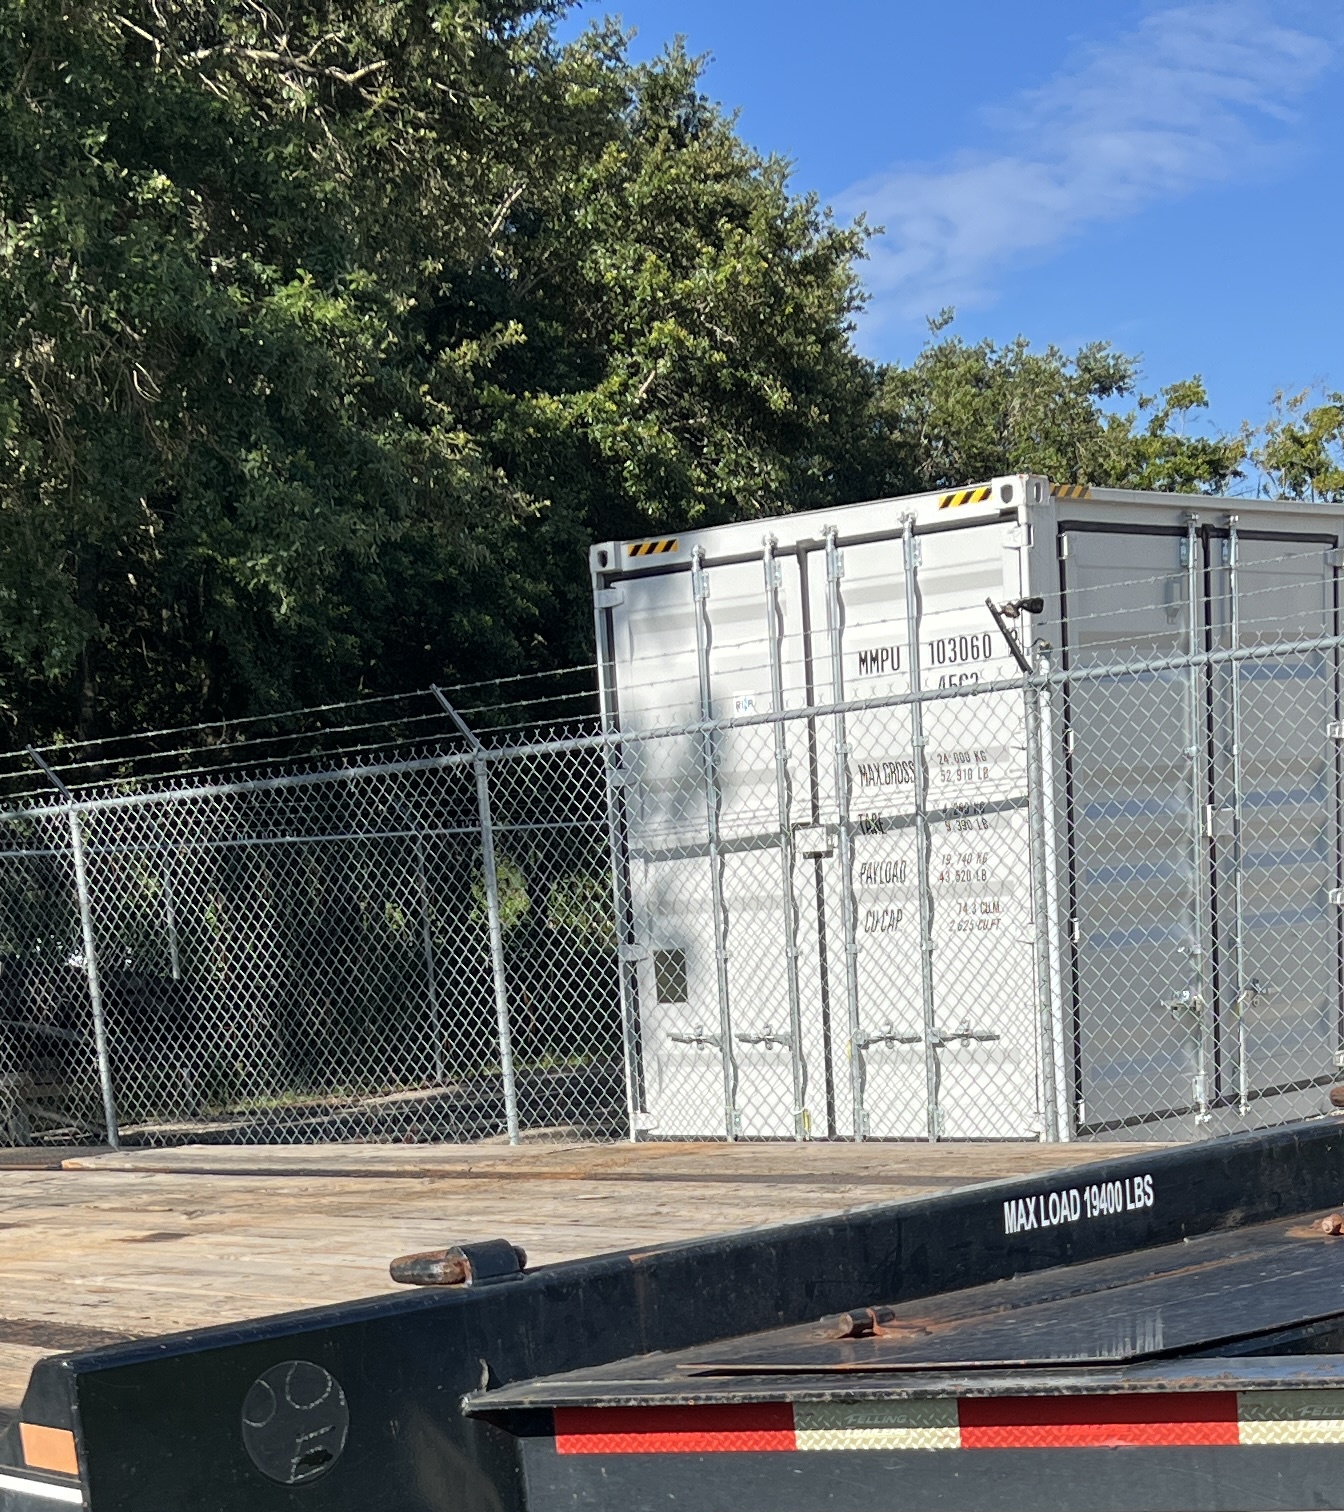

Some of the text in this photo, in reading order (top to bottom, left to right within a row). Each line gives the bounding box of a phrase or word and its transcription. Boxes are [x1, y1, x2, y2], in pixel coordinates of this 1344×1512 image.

[858, 646, 901, 676] MMPU
[928, 633, 992, 666] 103060
[977, 766, 989, 780] LB
[861, 860, 907, 884] PAYLOAD
[1003, 1174, 1155, 1235] MAX LOAD 19400 LBS
[843, 1411, 908, 1425] FELLING
